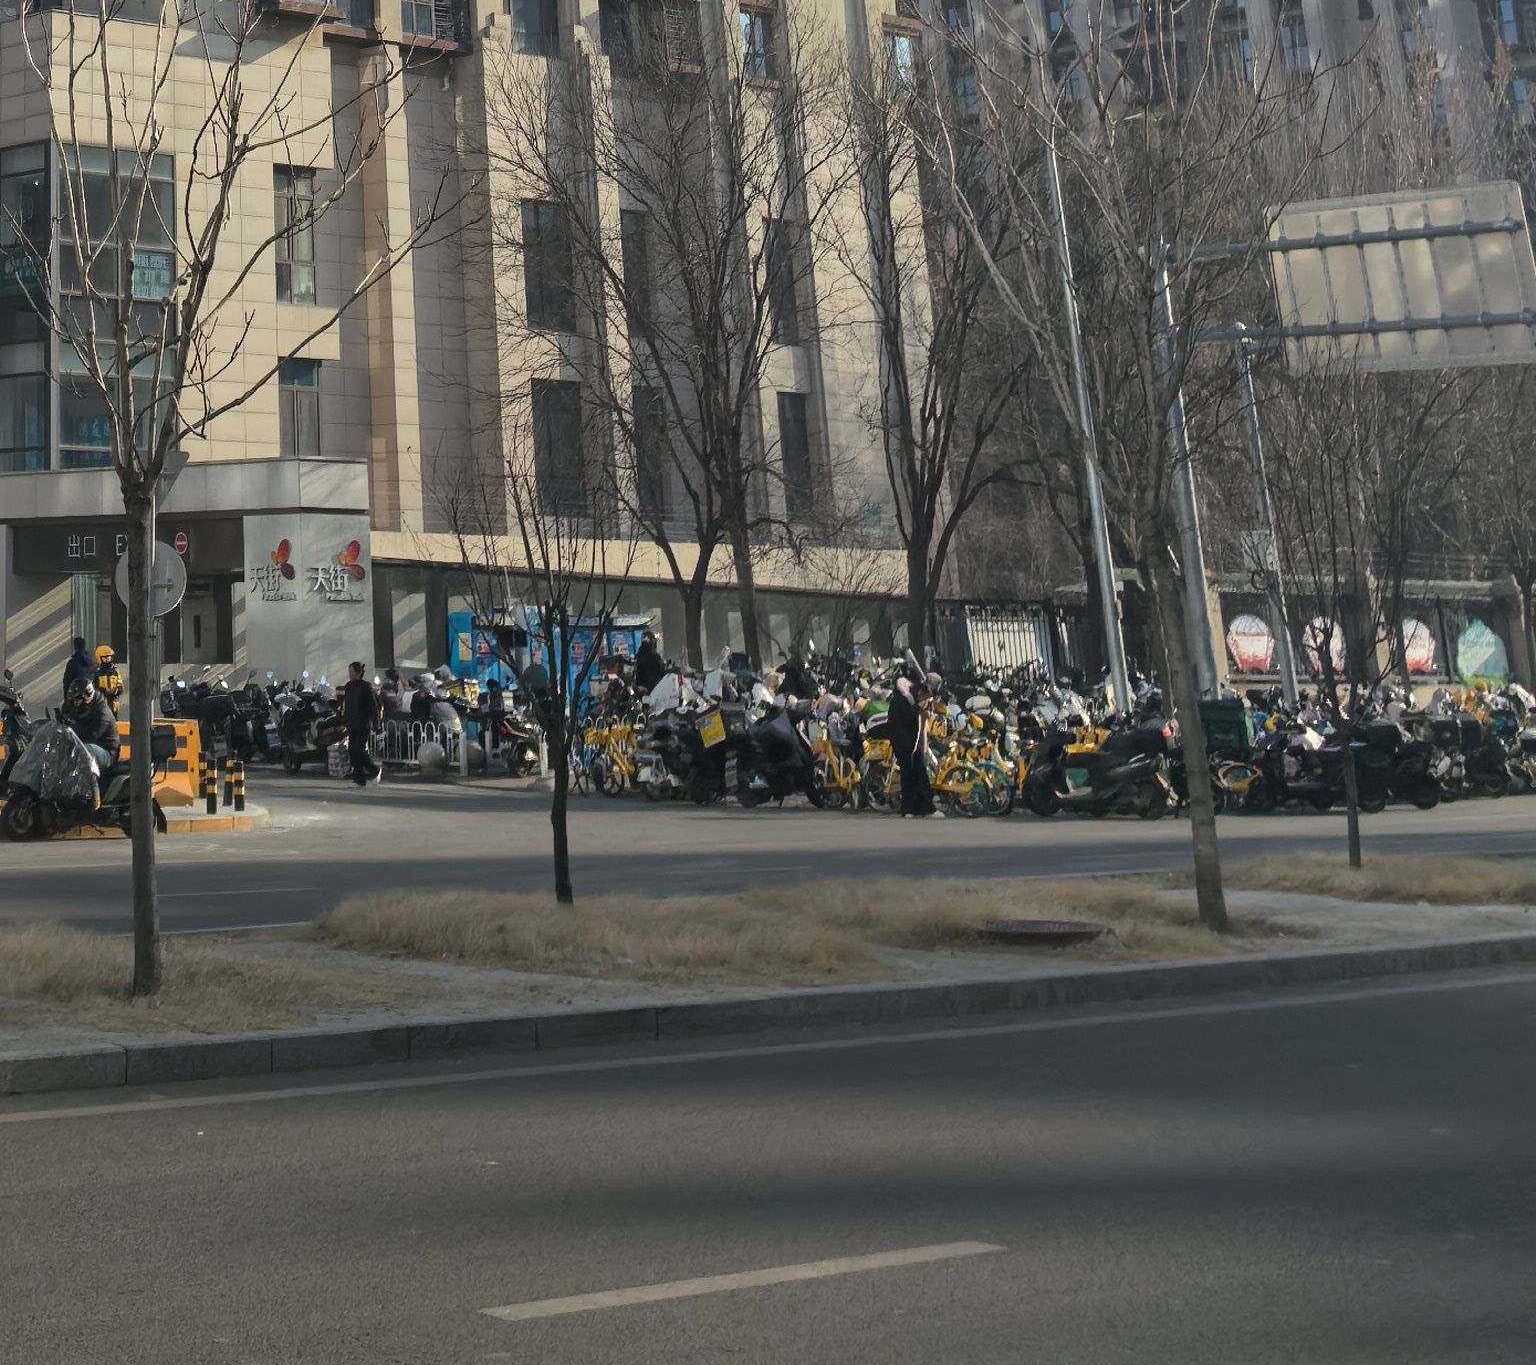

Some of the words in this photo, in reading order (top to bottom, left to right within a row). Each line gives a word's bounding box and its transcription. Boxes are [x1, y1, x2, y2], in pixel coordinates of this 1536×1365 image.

[68, 534, 96, 558] 出口
[250, 564, 282, 594] 天街
[309, 564, 349, 592] 天街
